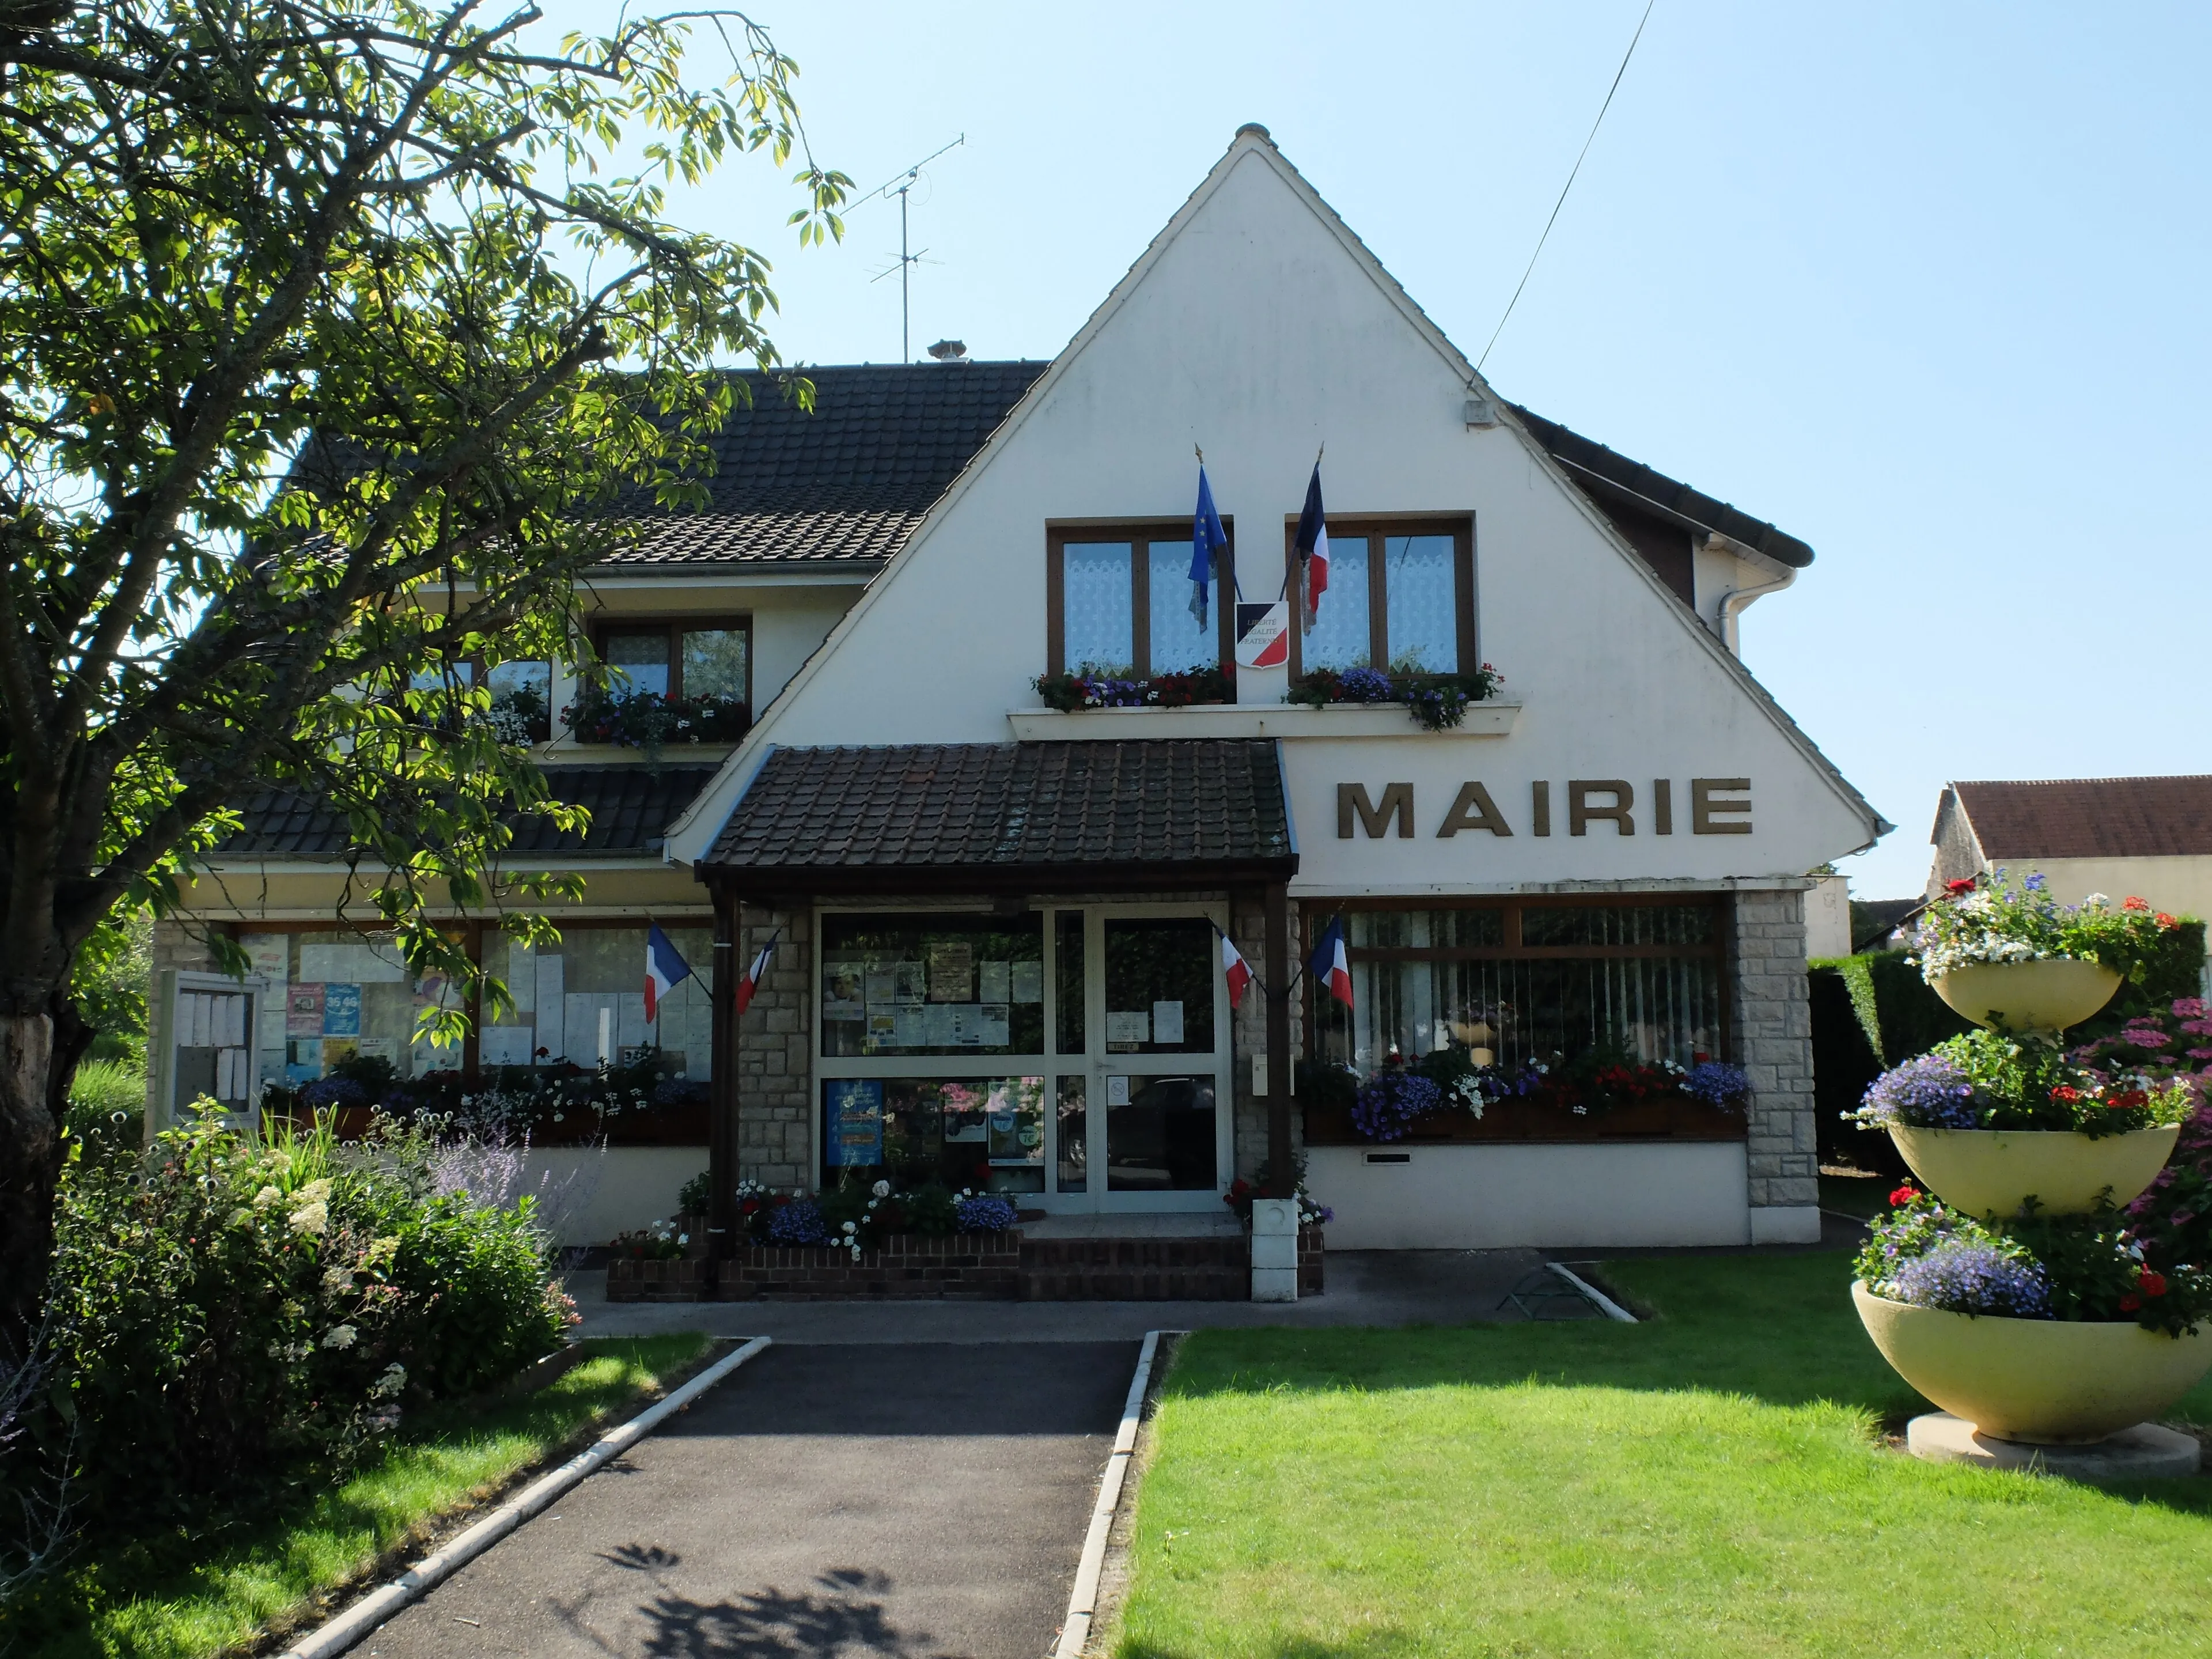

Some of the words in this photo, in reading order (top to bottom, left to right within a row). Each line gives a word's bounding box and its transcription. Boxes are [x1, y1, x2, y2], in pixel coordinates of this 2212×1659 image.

[1338, 778, 1753, 839] MAIRIE
[327, 997, 341, 1007] 36
[342, 997, 357, 1007] 46
